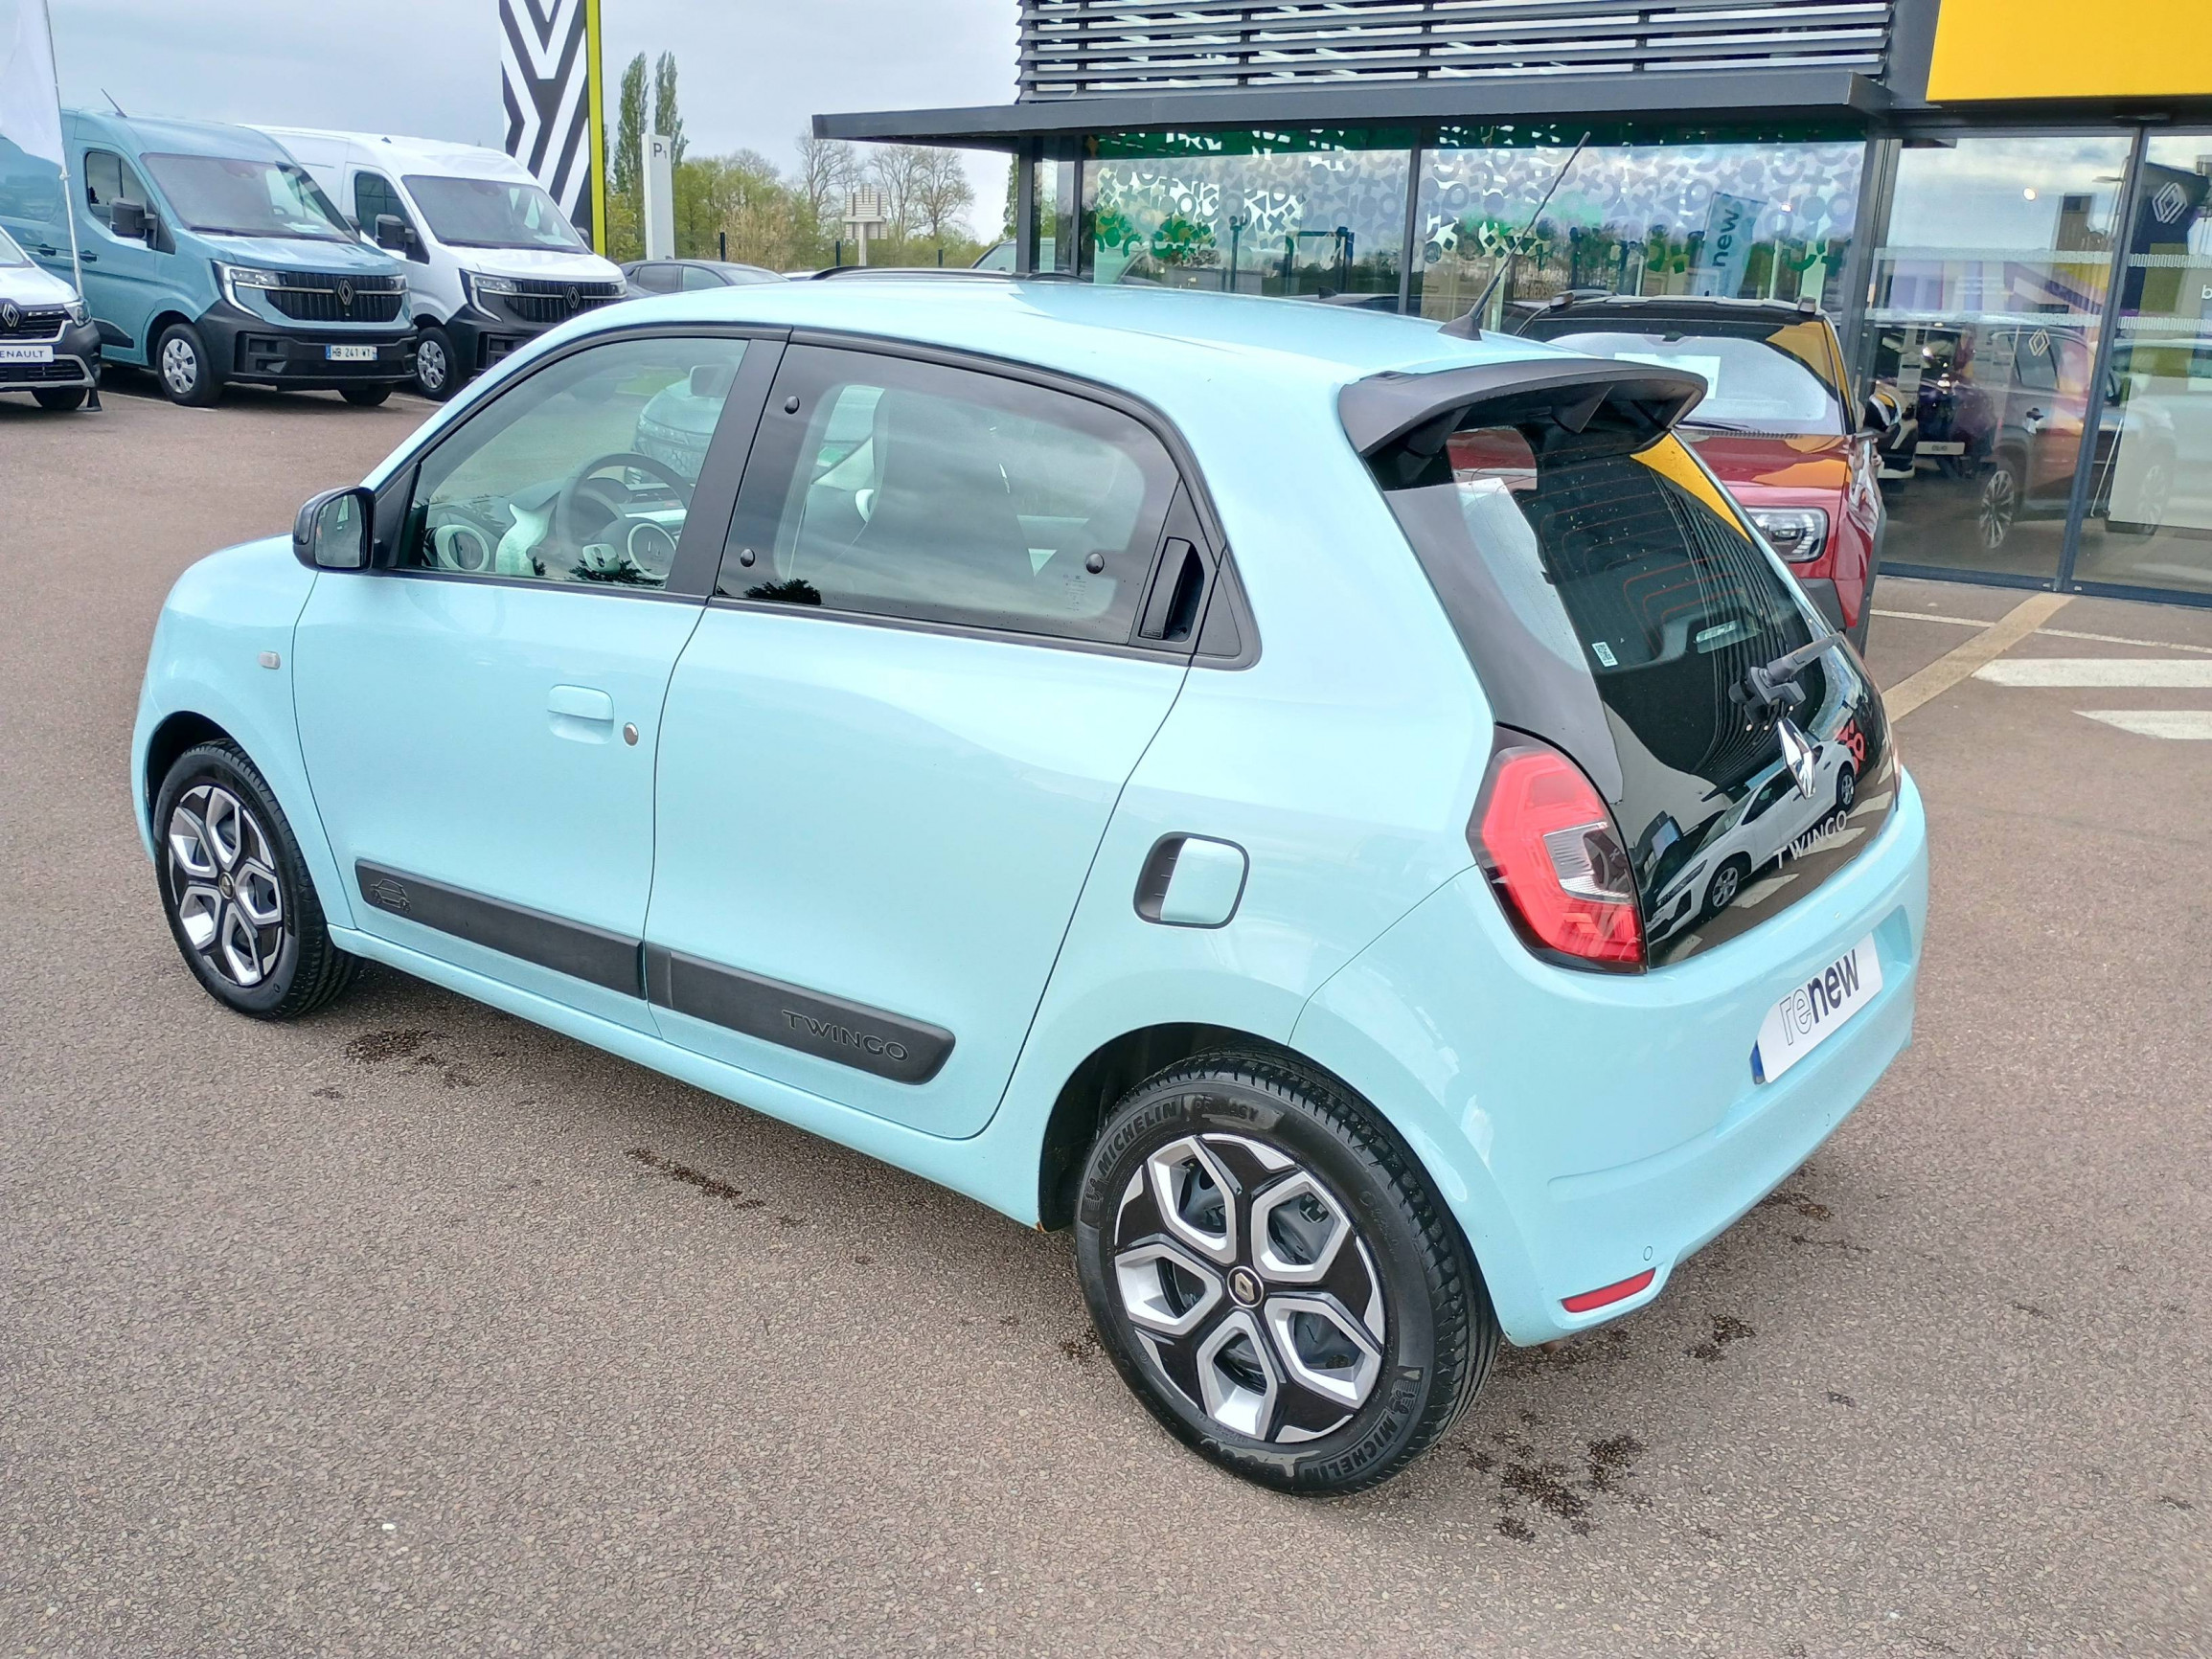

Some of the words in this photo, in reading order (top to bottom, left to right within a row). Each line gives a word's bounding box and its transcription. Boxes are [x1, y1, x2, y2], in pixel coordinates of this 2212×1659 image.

[0, 350, 45, 359] ENAULT
[1772, 809, 1848, 870] TWINGO
[1779, 948, 1860, 1047] renew
[781, 1009, 910, 1062] TWINGO
[1096, 1100, 1178, 1179] MICHELIN
[1302, 1416, 1400, 1483] MICHELIN
